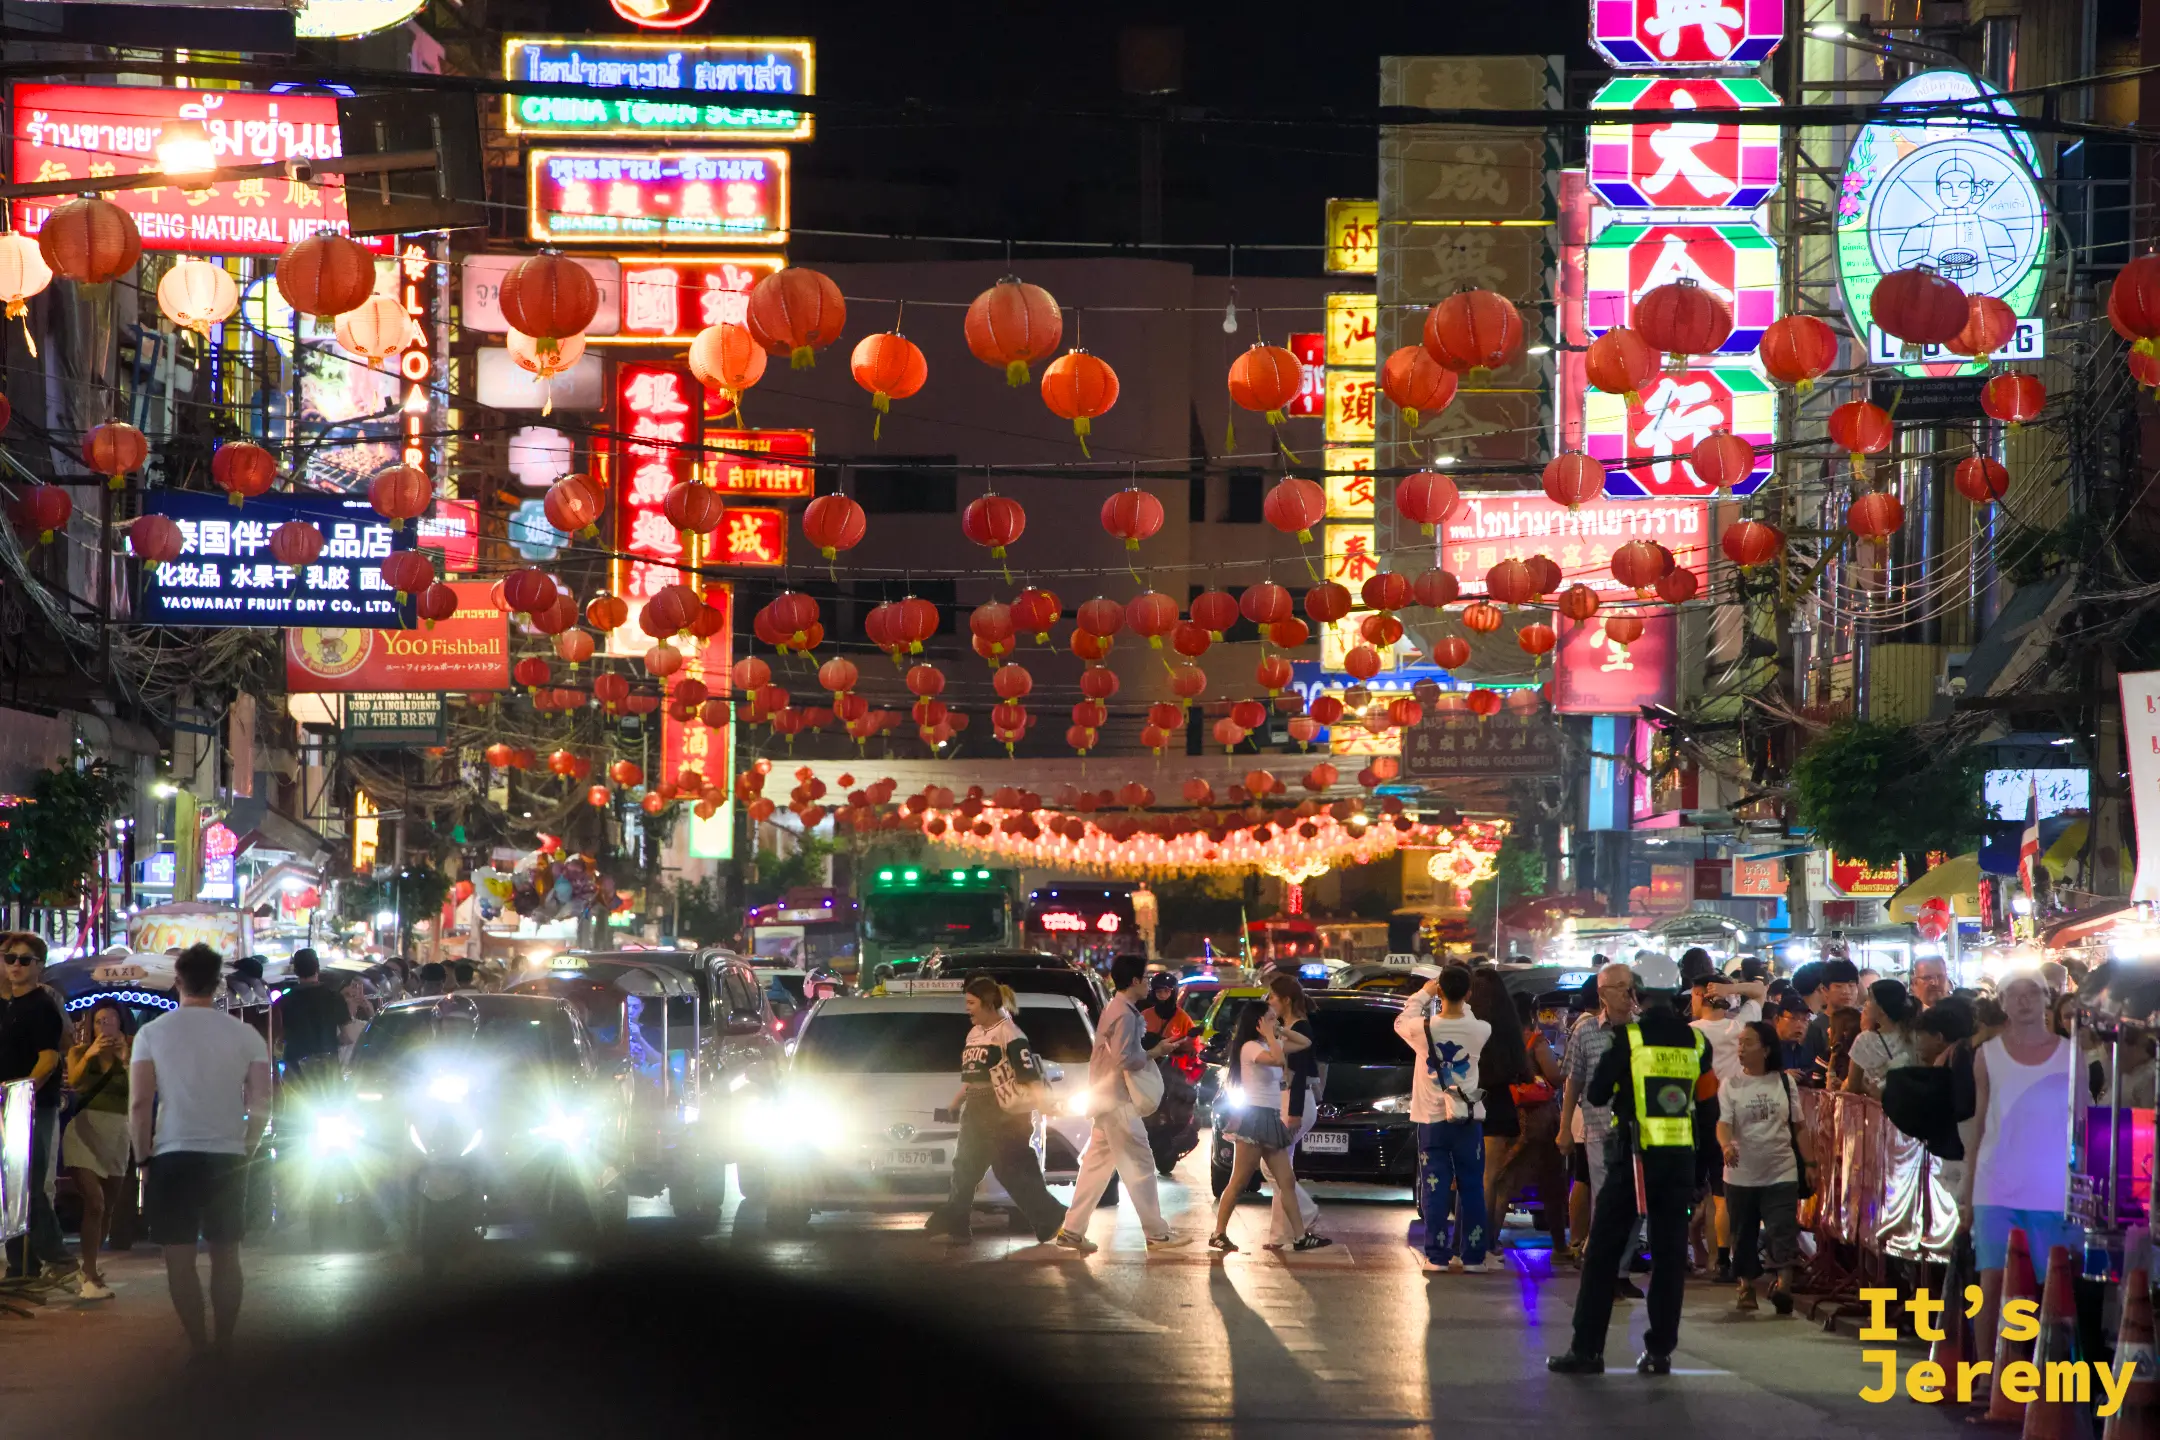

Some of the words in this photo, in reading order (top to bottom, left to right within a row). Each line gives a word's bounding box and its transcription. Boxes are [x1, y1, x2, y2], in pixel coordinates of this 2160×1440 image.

[522, 96, 607, 122] CHINA
[615, 99, 697, 123] TOWN
[191, 215, 284, 243] NATURAL
[155, 561, 221, 589] 化妆品
[231, 563, 296, 590] 水果干
[306, 564, 350, 591] 乳胶
[161, 596, 243, 611] YAOWARAT
[247, 597, 292, 611] FRUIT
[296, 599, 326, 612] DRY
[365, 600, 396, 613] LTD.
[431, 639, 501, 655] Fishball
[349, 700, 371, 711] USED
[373, 700, 384, 711] AS
[385, 700, 441, 711] INGREDIENTS
[353, 712, 367, 726] IN
[371, 712, 397, 726] THE
[401, 712, 436, 726] BREW
[1388, 956, 1411, 965] TAXI
[103, 967, 136, 978] TAXI
[1325, 1133, 1348, 1144] 5788
